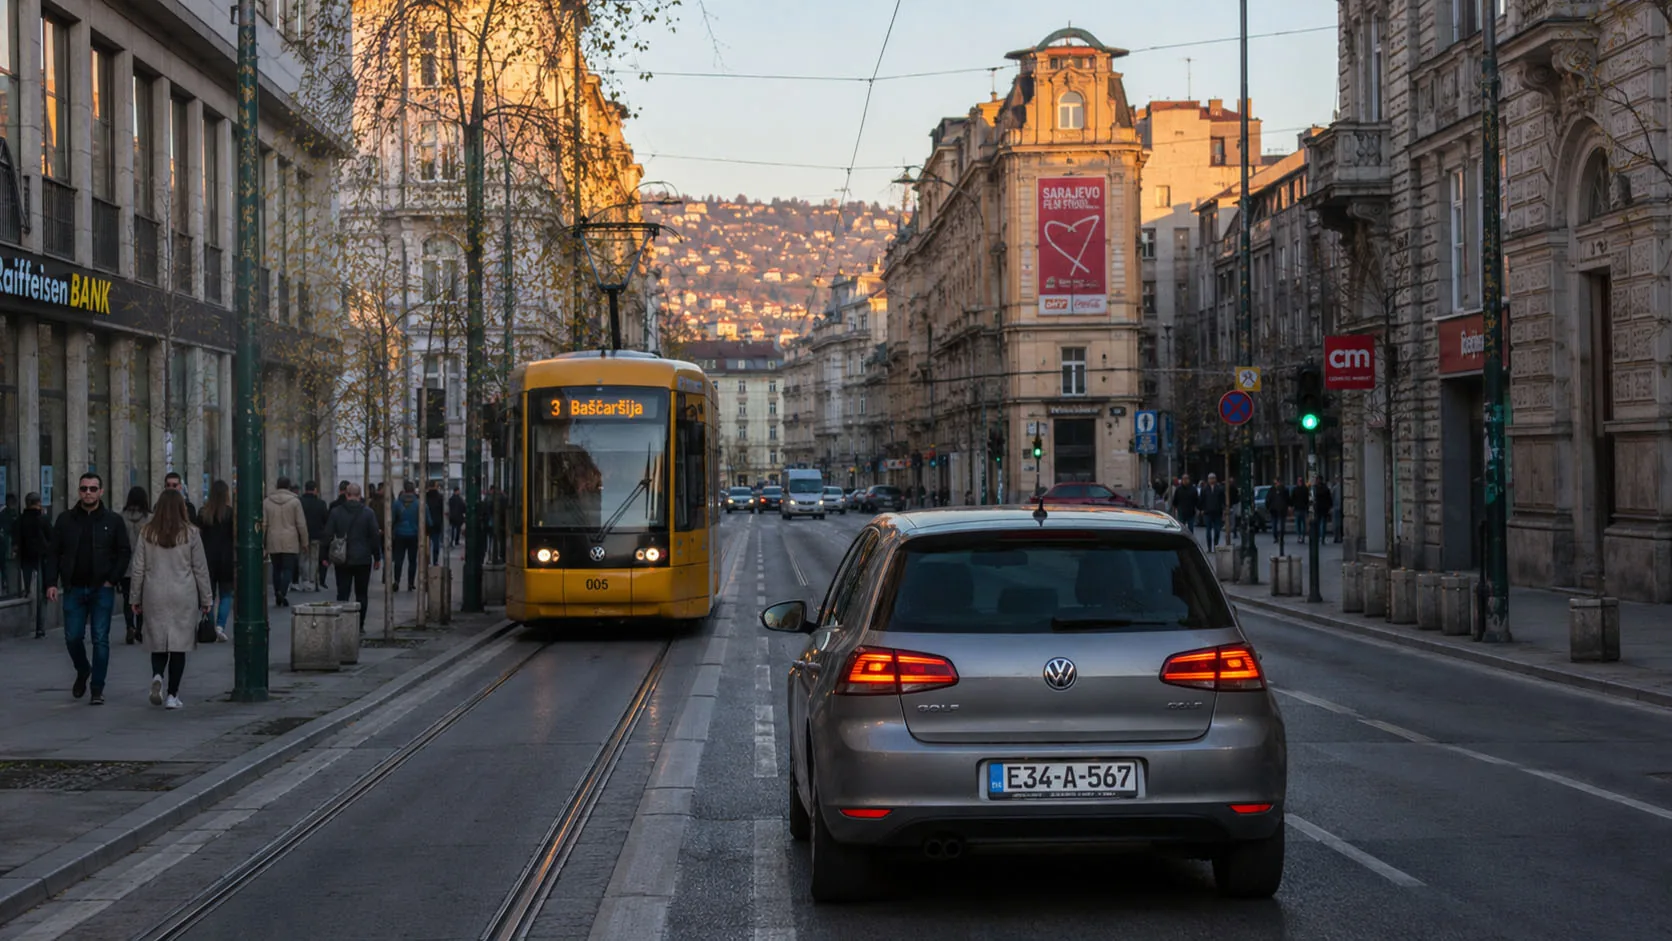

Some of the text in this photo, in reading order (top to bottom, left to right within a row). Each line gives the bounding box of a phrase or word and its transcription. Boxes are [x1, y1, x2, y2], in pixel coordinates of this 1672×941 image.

[1043, 186, 1101, 199] SARAJEVO
[70, 272, 112, 315] BANK
[1329, 348, 1370, 369] cm
[551, 399, 643, 418] 3 Baščaršija
[586, 578, 609, 590] 005
[1007, 765, 1132, 789] E34-A-567
